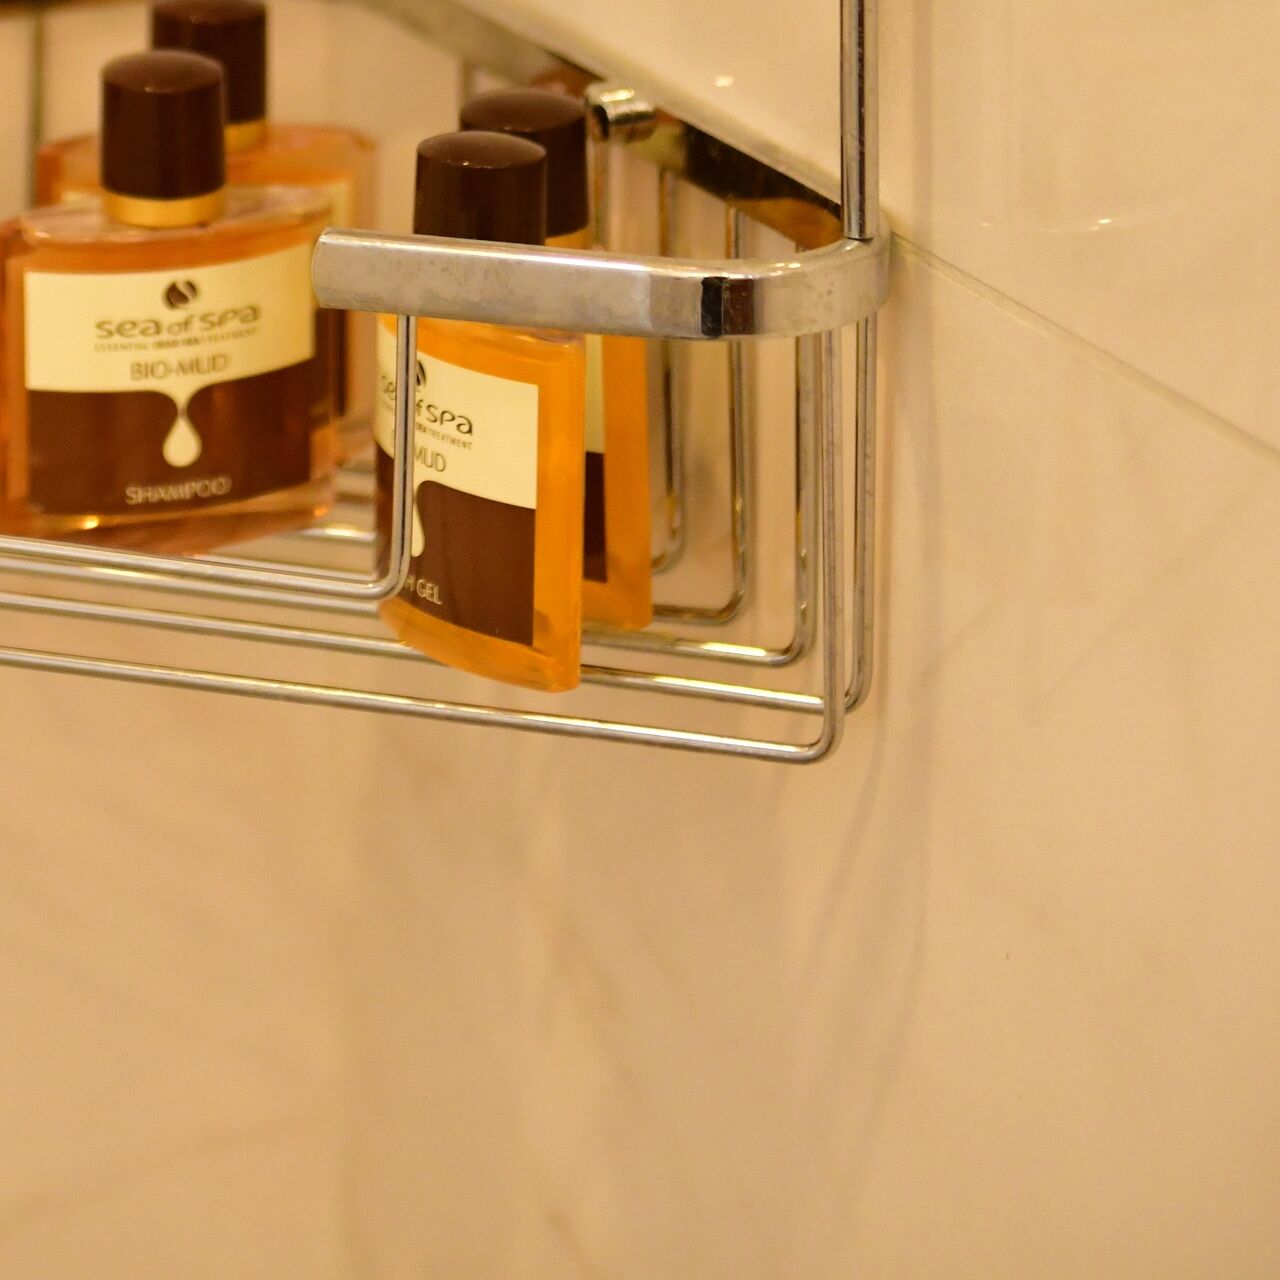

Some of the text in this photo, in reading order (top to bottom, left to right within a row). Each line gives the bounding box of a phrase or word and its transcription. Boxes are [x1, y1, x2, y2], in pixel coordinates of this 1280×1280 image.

[166, 313, 195, 336] of
[131, 353, 230, 380] BIO-MUD
[125, 477, 231, 505] SHAMPOO
[416, 578, 443, 605] GEL
